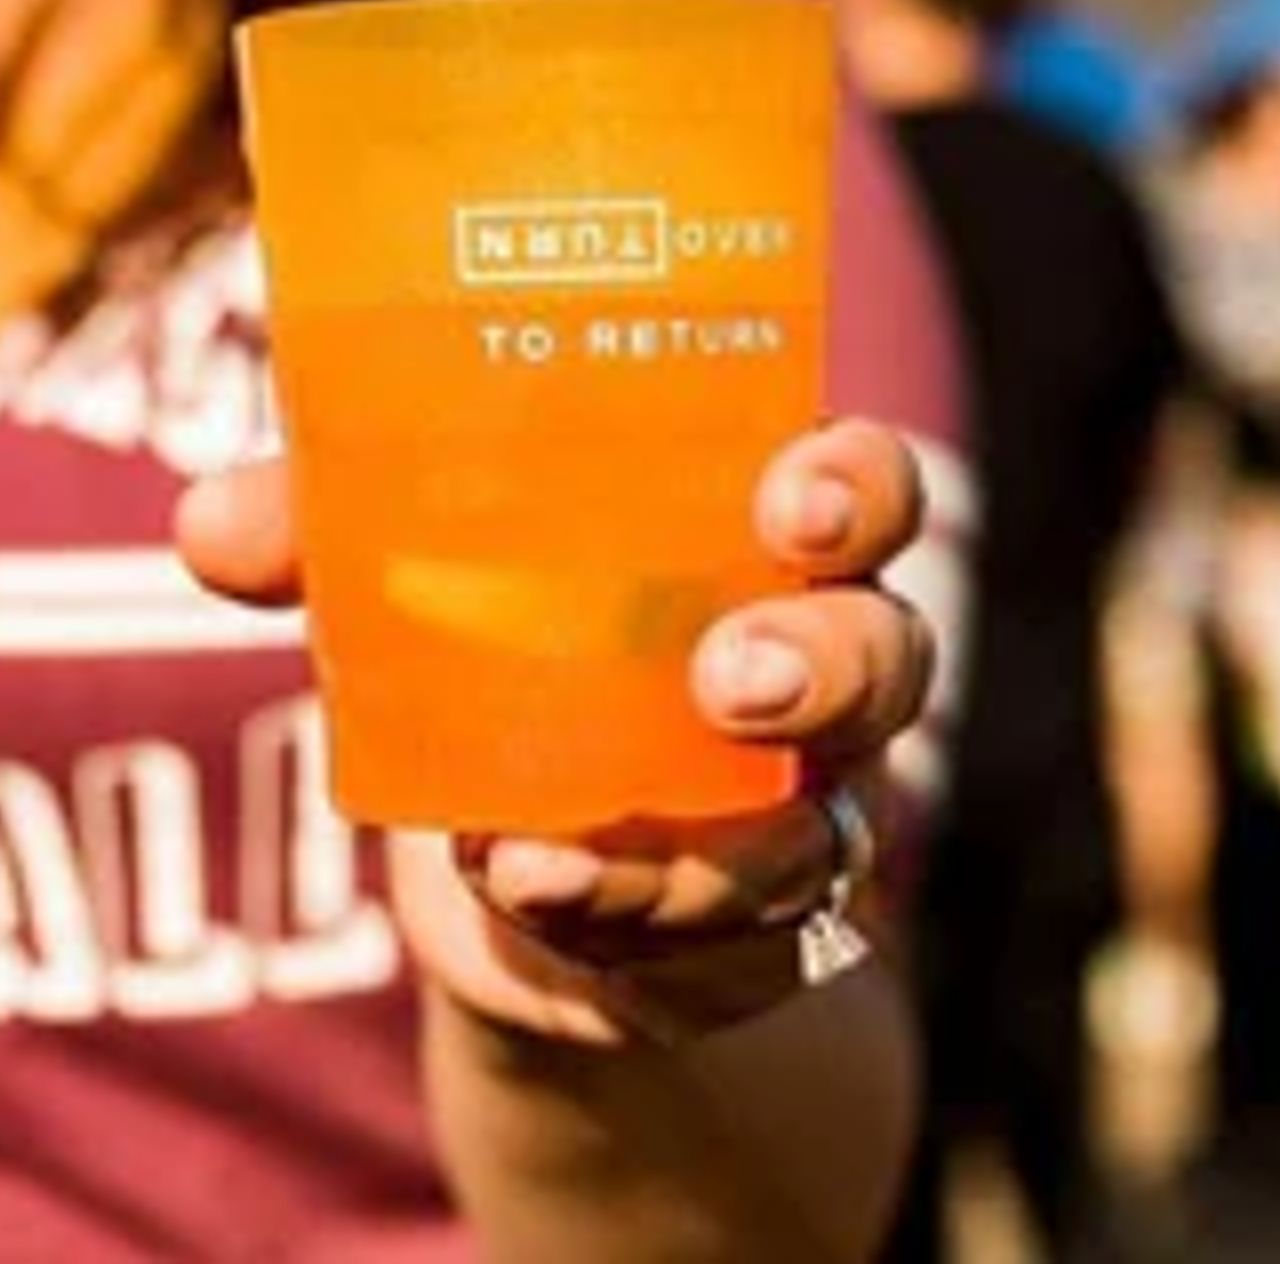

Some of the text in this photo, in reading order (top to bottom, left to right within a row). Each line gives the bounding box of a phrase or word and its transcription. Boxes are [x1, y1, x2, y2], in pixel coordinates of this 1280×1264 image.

[478, 221, 650, 259] TURN
[480, 318, 786, 363] TO RETURN
